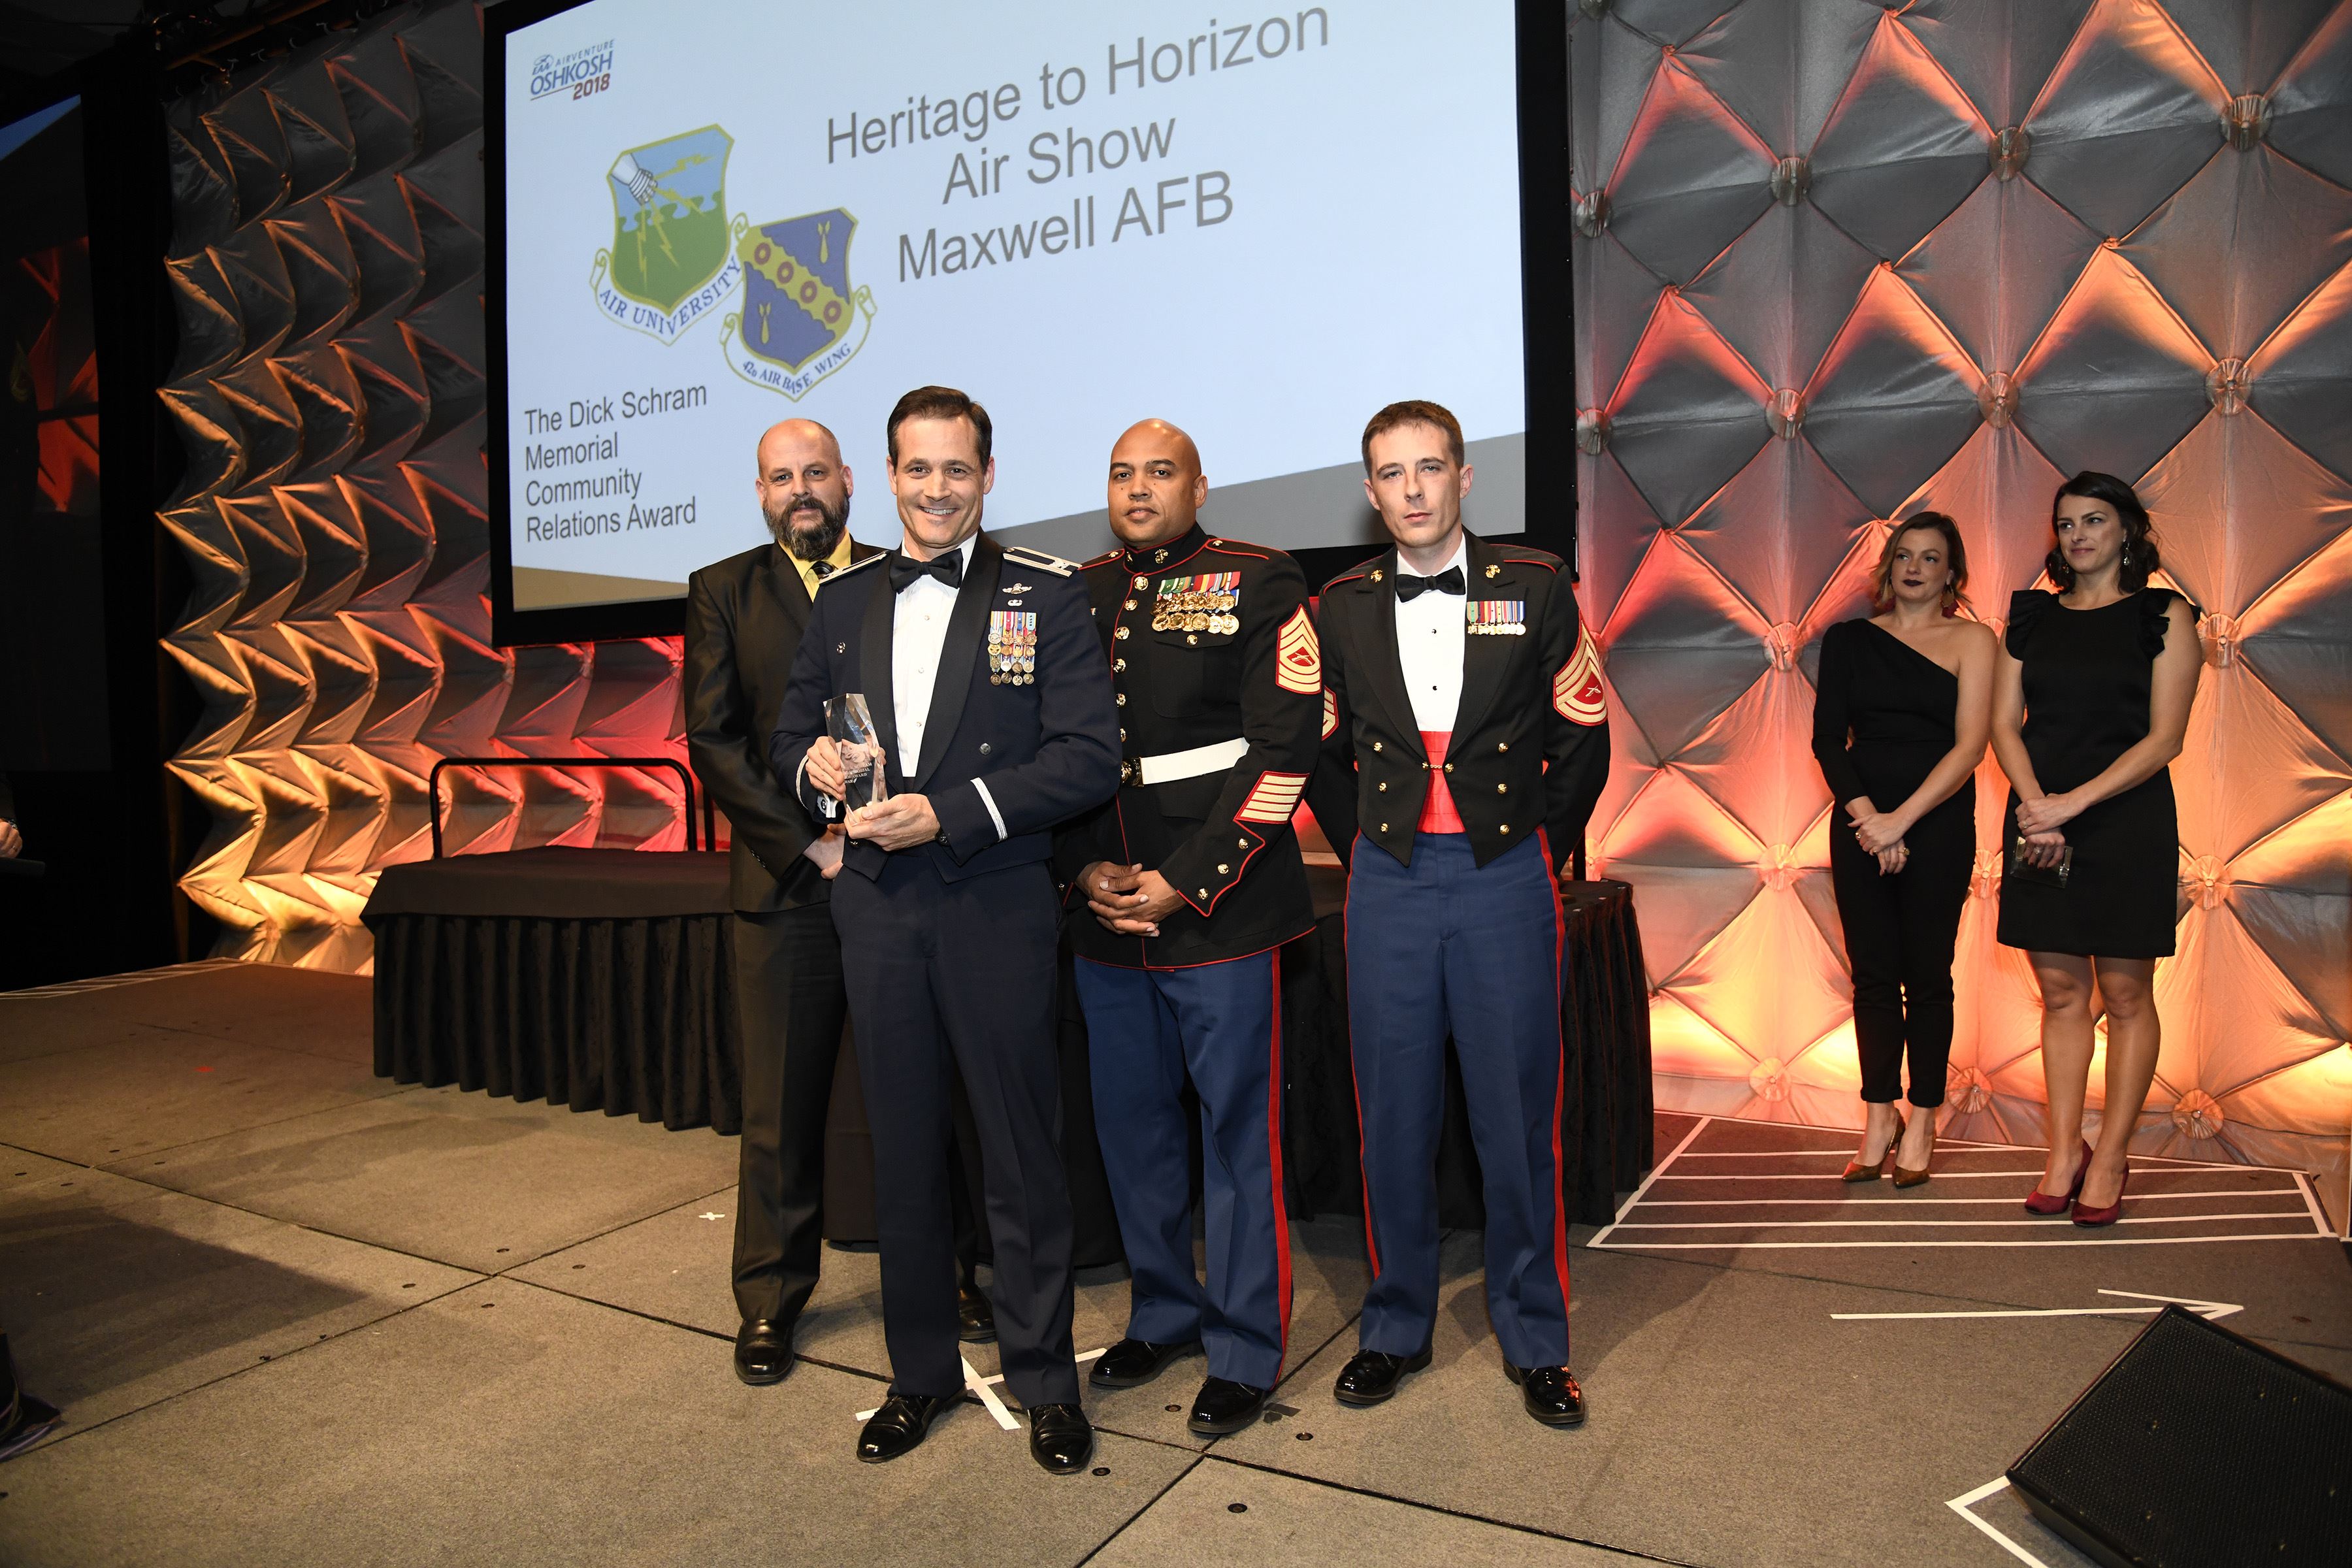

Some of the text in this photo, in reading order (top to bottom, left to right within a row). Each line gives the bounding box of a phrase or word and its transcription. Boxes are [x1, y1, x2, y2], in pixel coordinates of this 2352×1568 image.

[531, 50, 613, 95] OSHKOSH
[555, 39, 614, 66] AIRVENTURE
[573, 73, 611, 101] 2018
[827, 7, 1330, 164] Heritage to Horizon
[942, 118, 1177, 204] Air Show
[899, 170, 1233, 283] Maxwell AFB
[600, 255, 742, 336] AIR UNIVERSITY
[759, 368, 781, 386] AIR
[782, 373, 813, 394] BASE
[814, 343, 851, 375] WING
[525, 385, 707, 435] The Dick Schram
[526, 431, 618, 471] Memorial
[527, 467, 642, 506] Community
[527, 495, 696, 543] Relations Award
